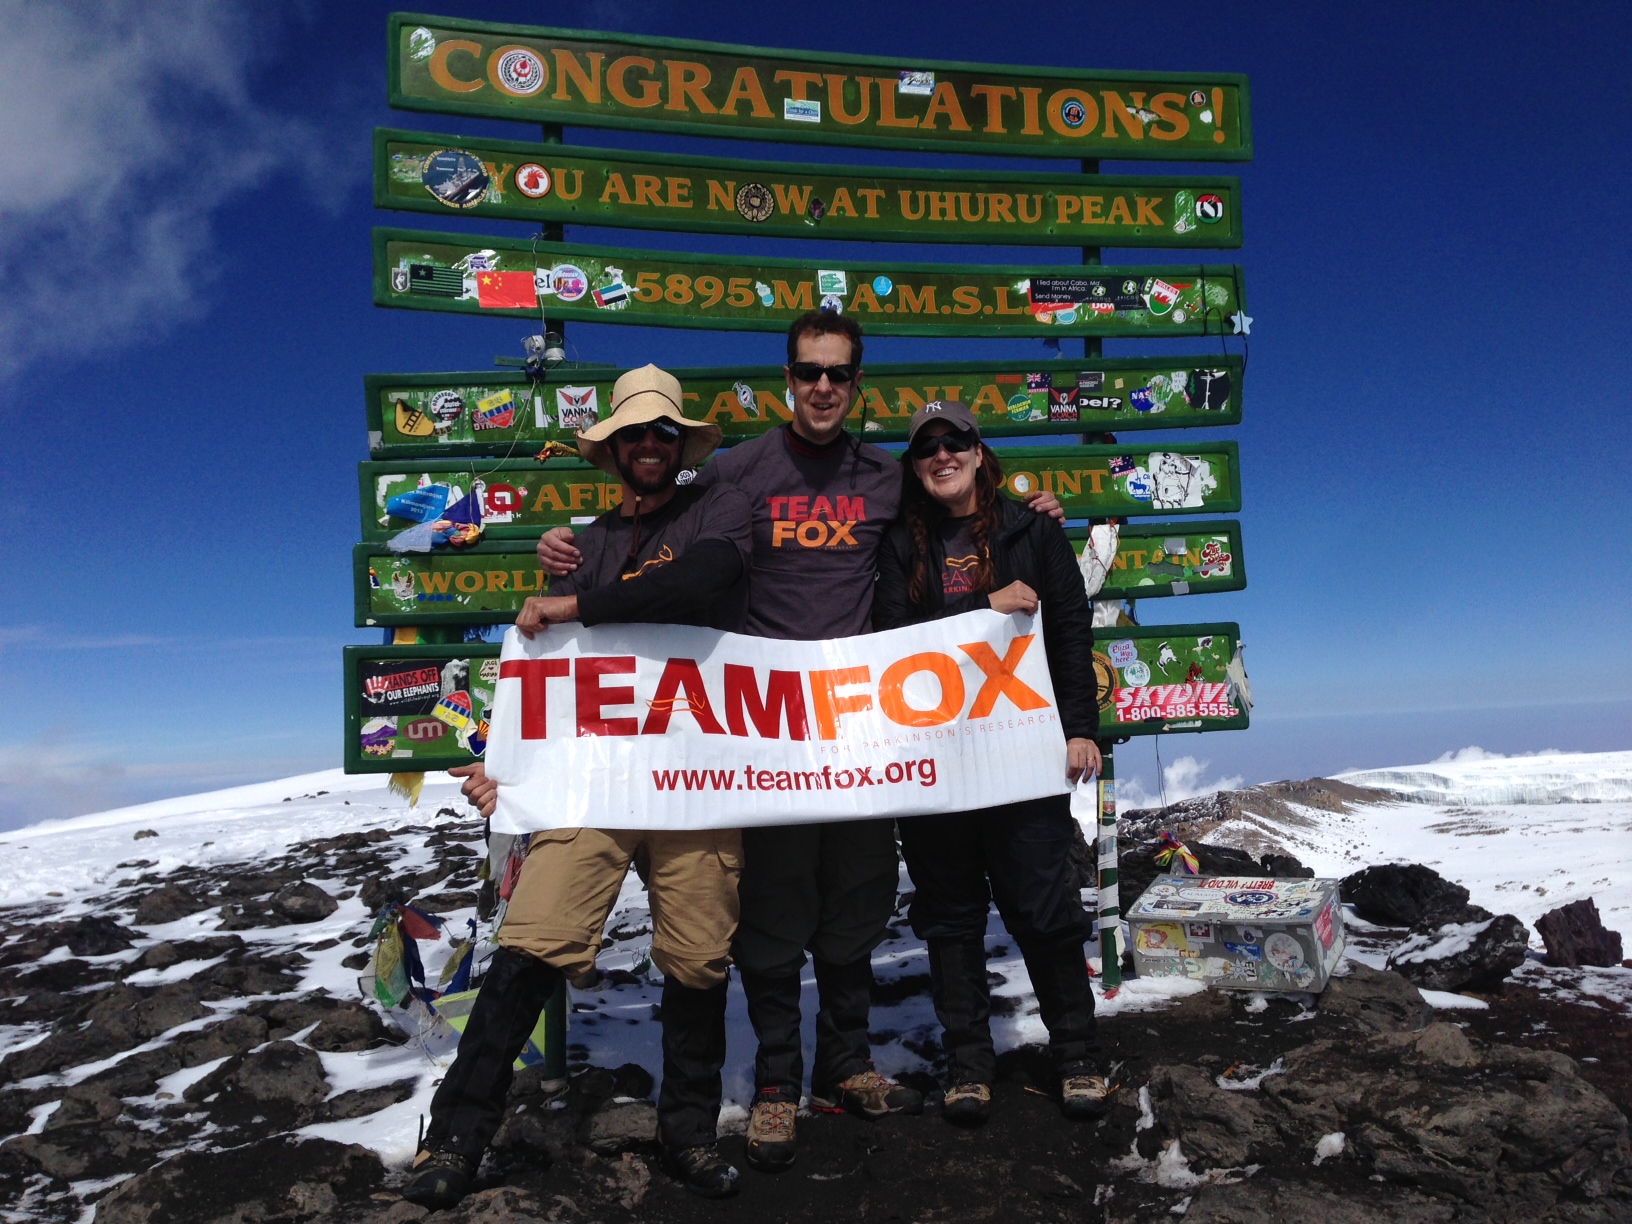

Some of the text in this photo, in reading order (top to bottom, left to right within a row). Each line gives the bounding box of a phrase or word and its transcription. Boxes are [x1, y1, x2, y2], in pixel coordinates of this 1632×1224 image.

[429, 40, 1226, 144] CONGRATULATIONS!
[484, 162, 1164, 227] YU ARE NW AT UHURU PEAK
[636, 272, 755, 310] 5895
[773, 281, 817, 310] M
[1157, 280, 1179, 295] WALES
[682, 384, 1008, 424] ANANIA
[1131, 391, 1150, 400] NAS
[1050, 404, 1077, 413] VANNA
[766, 496, 867, 521] TEAM
[772, 520, 859, 548] FOX
[1110, 548, 1200, 570] NTAIN
[385, 669, 437, 690] HANDS OFF
[386, 682, 440, 701] OUR ELEPHANTS
[407, 721, 443, 739] um
[820, 713, 1057, 755] FOR PARKINSON'S RESEARCH
[651, 757, 937, 791] www.teamfox.org
